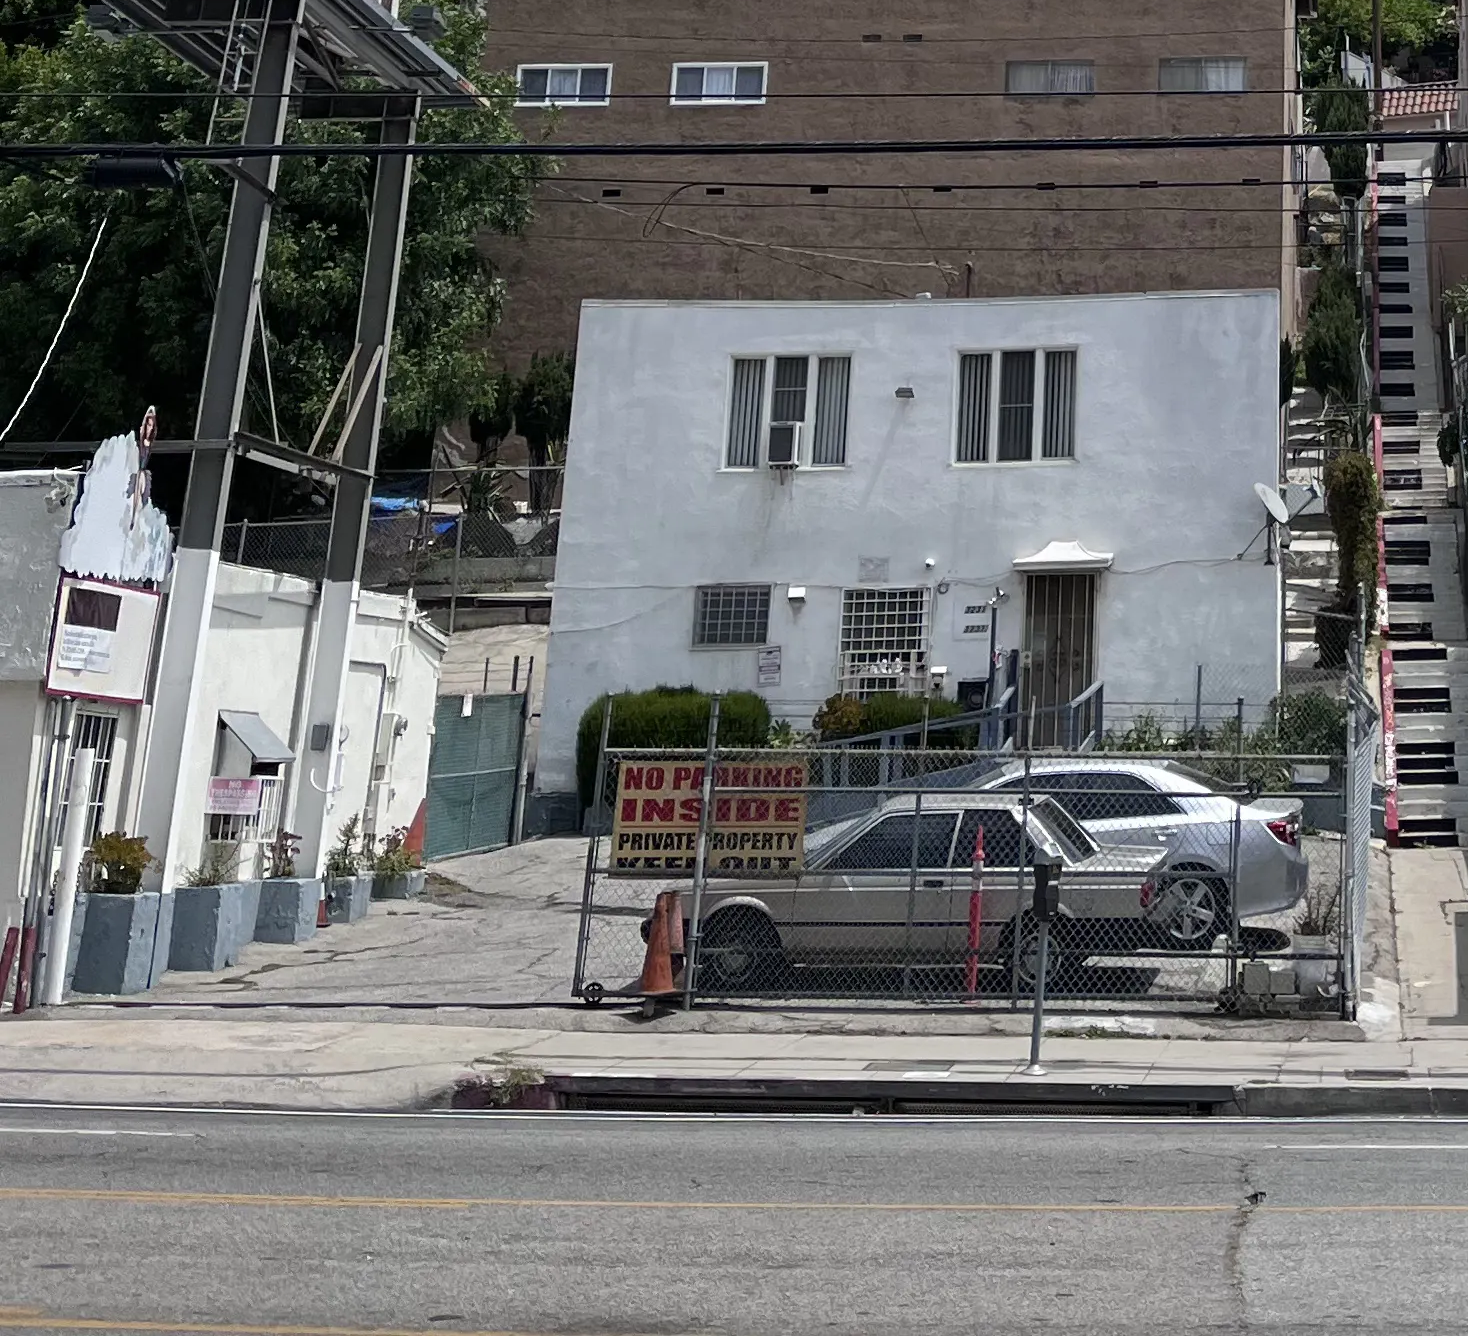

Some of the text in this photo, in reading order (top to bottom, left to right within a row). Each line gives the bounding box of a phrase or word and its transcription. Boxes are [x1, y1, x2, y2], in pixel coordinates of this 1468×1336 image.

[624, 766, 804, 790] NO PARKING
[621, 798, 801, 822] INSIDE
[618, 832, 696, 851] PRIVATE
